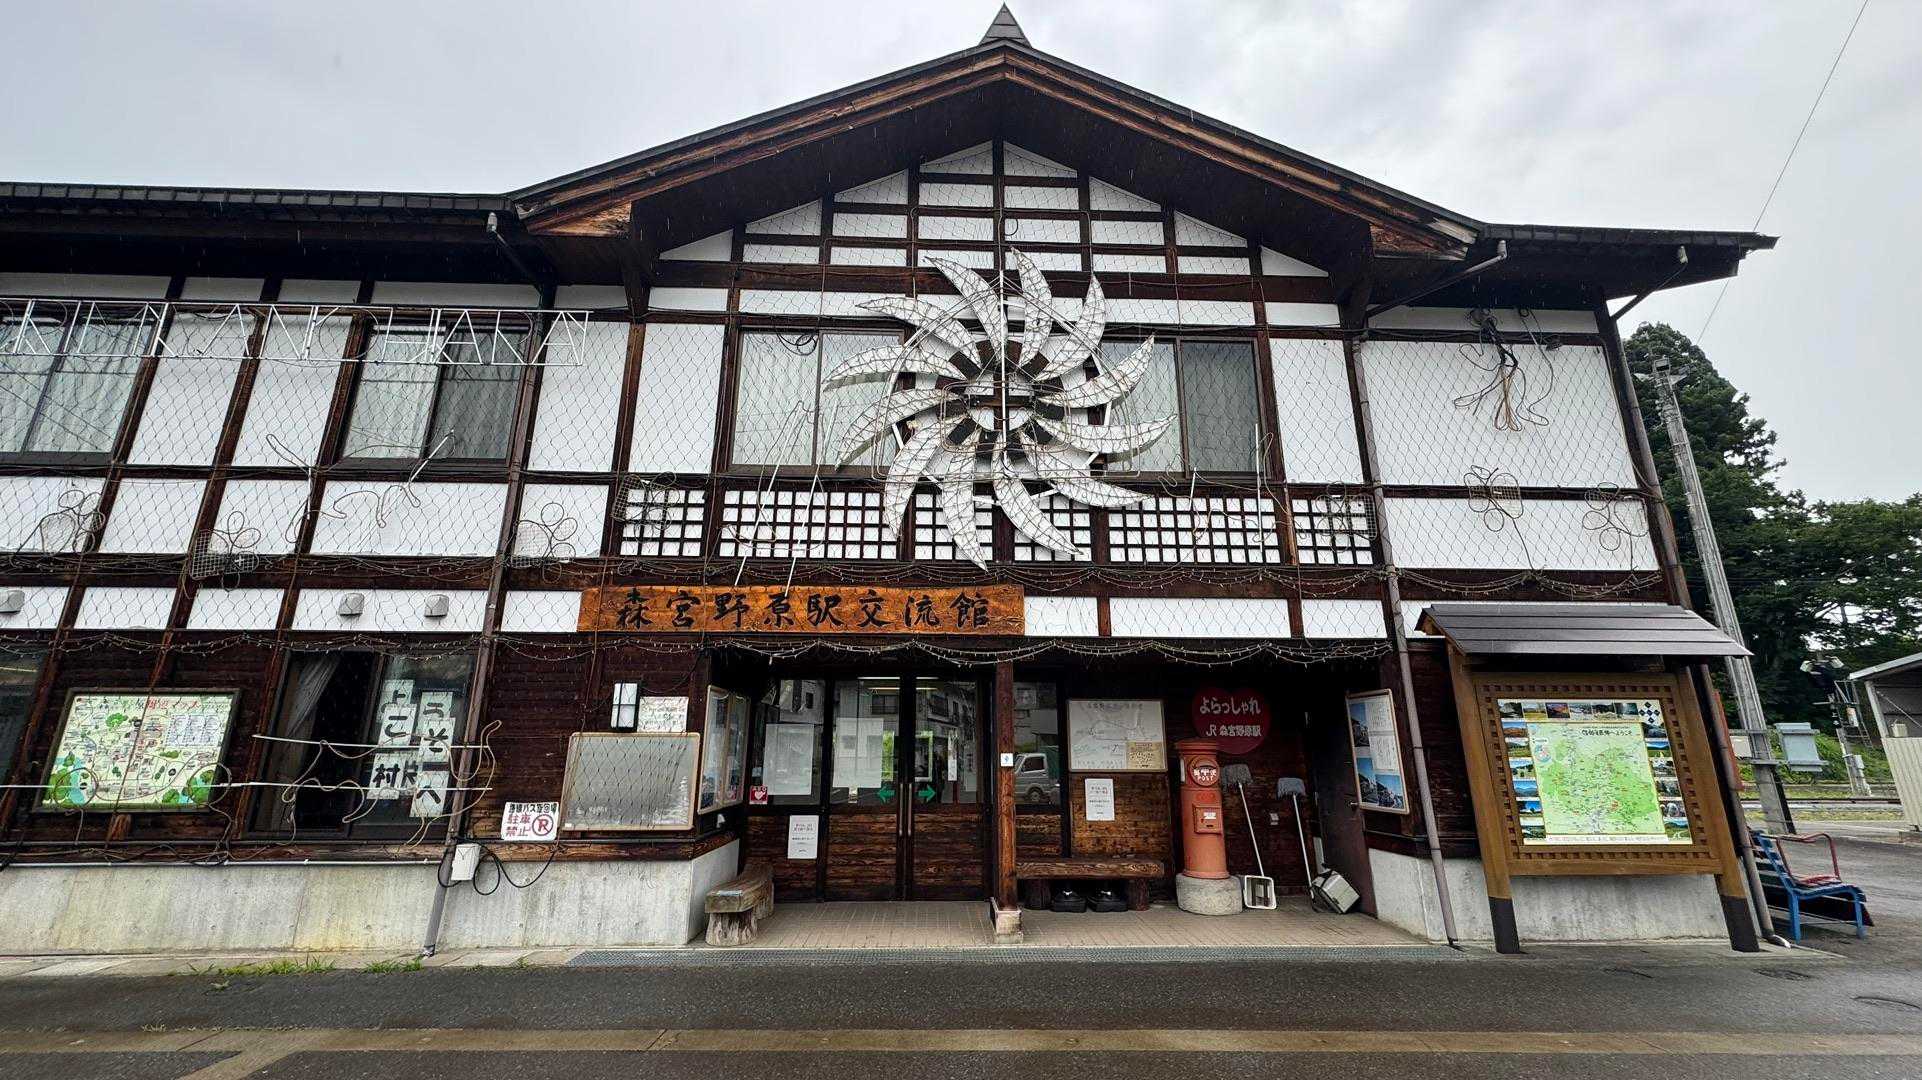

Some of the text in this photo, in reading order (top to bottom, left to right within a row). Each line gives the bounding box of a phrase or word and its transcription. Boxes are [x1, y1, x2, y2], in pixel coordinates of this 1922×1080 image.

[615, 588, 990, 628] 森宮野原駅交流館
[1199, 696, 1261, 715] よらっしゃれ
[1206, 724, 1262, 736] JR 森宮野原駅
[507, 812, 531, 824] 駐車
[505, 826, 531, 837] 禁止
